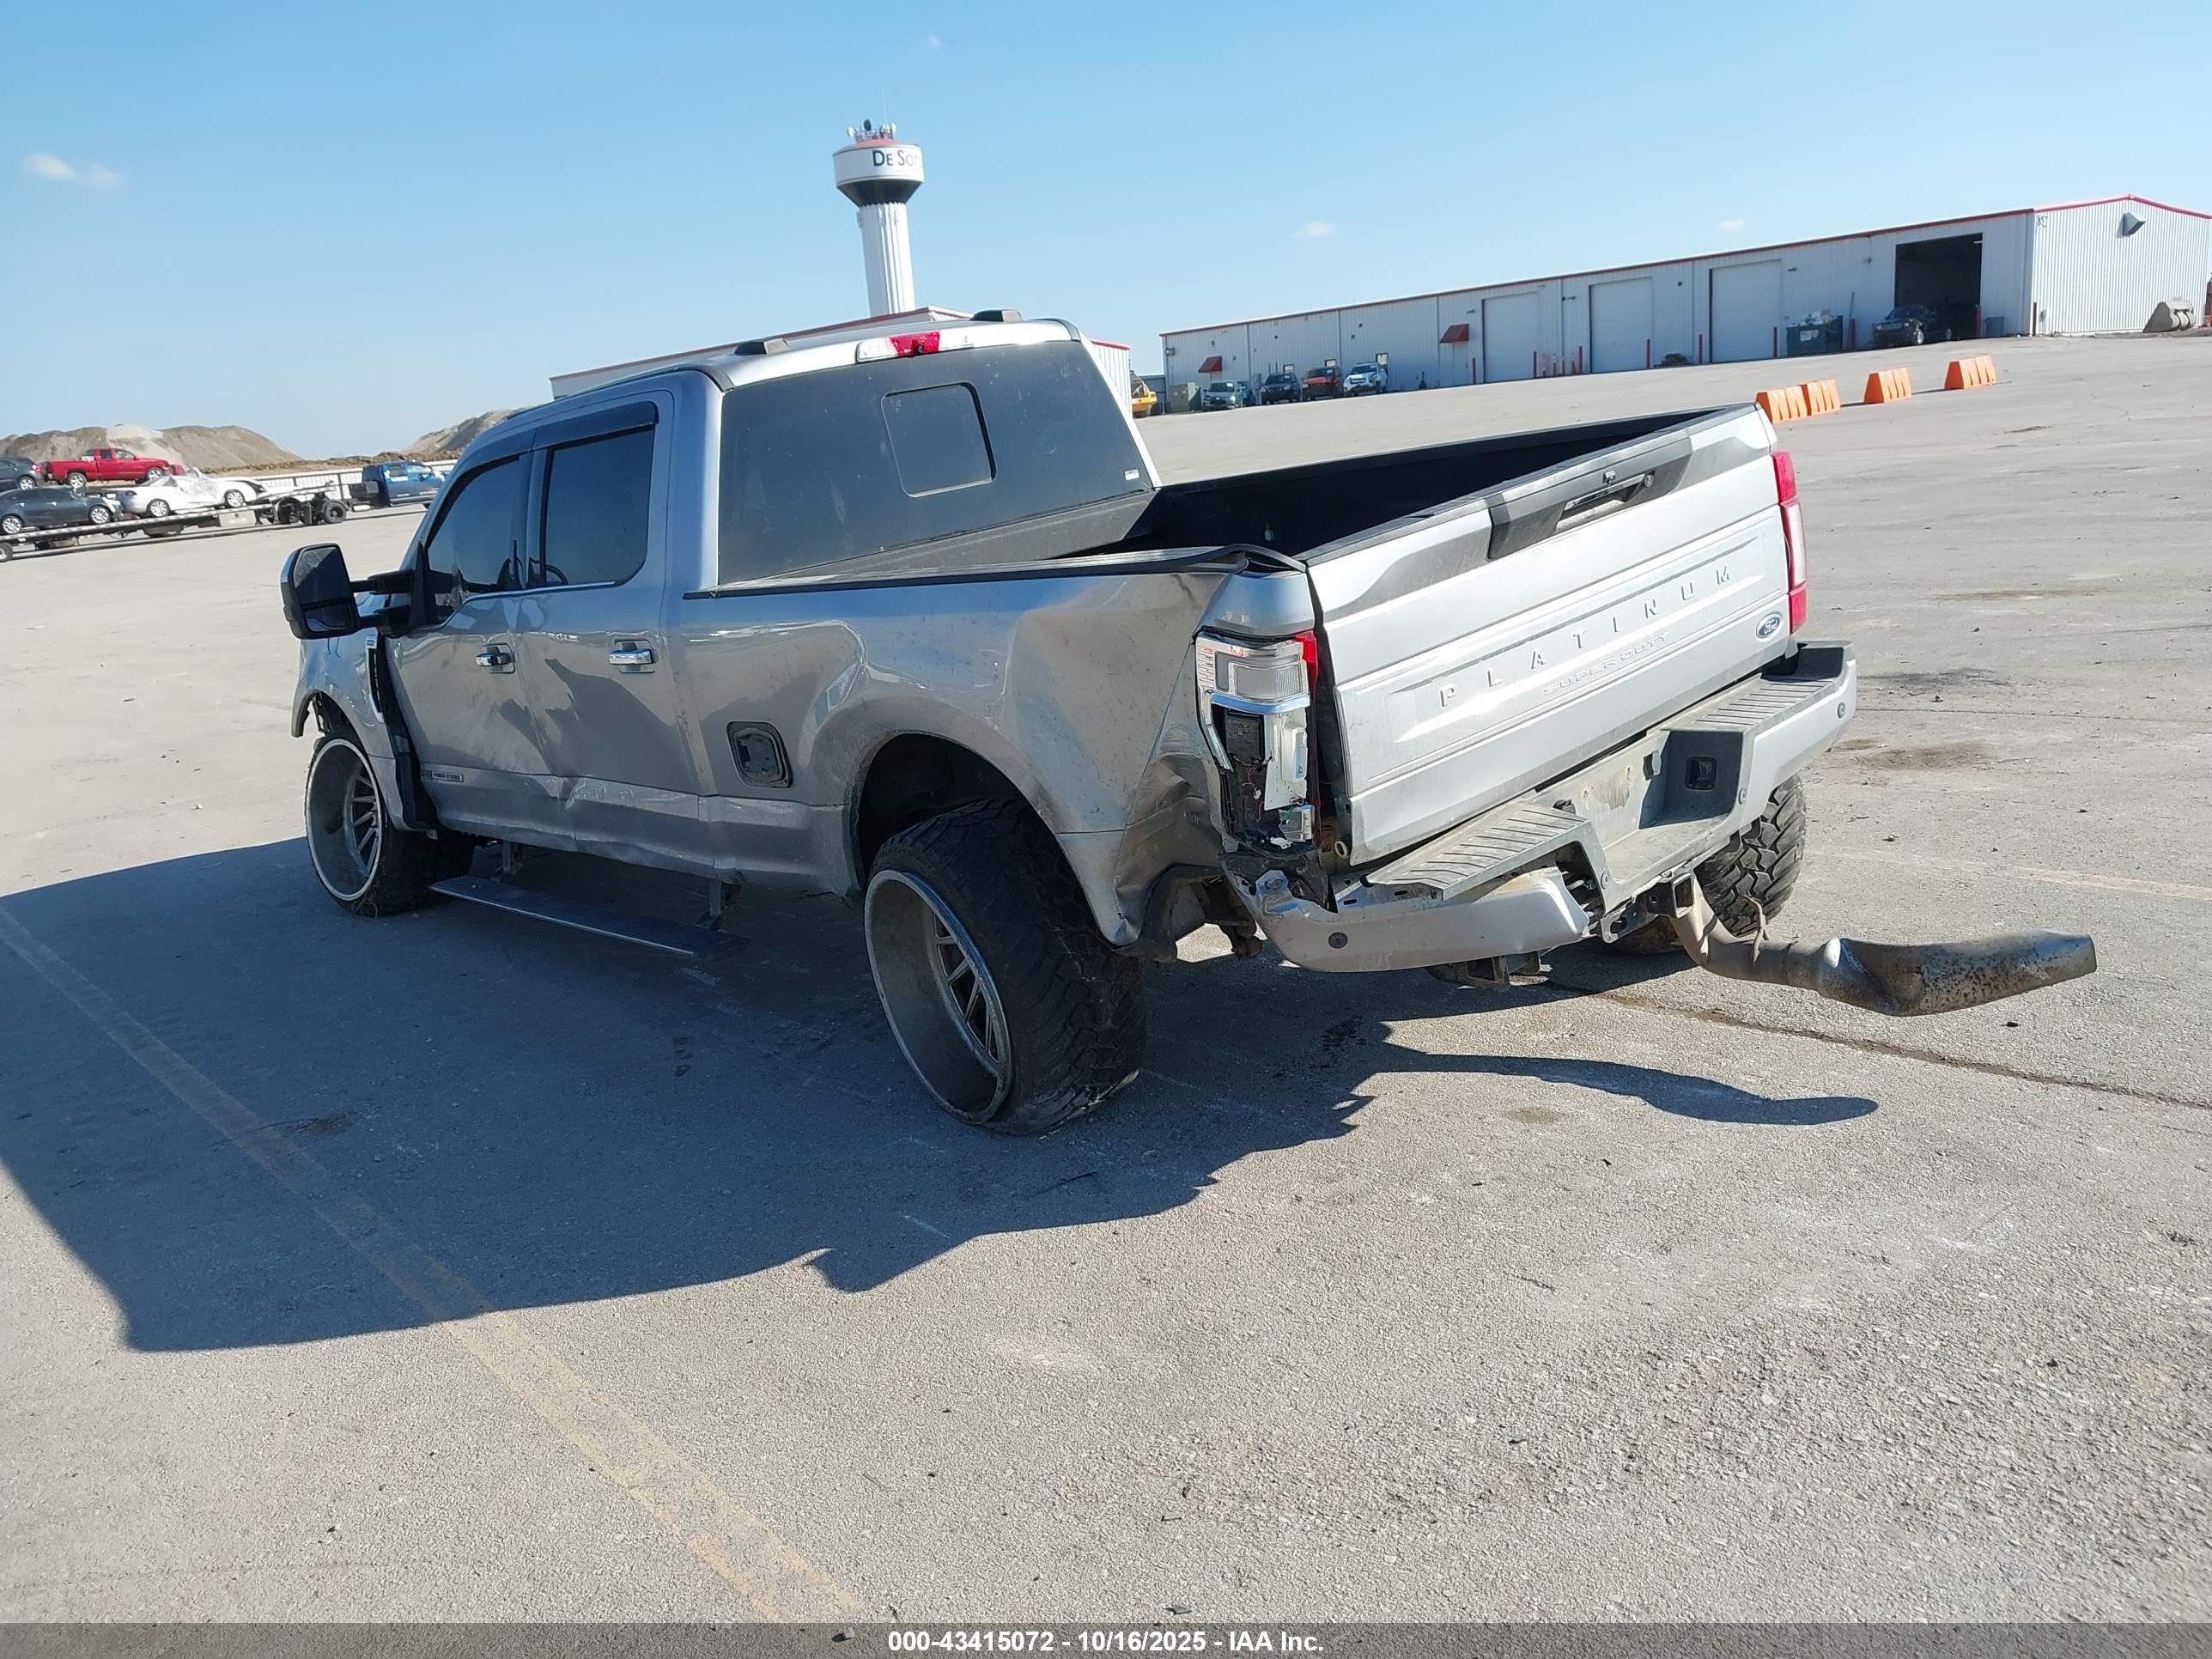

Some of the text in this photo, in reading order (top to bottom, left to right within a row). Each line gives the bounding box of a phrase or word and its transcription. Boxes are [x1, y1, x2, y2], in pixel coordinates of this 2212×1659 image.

[1438, 563, 1733, 708] PLATINUM
[1543, 630, 1670, 695] SUPER DUTY
